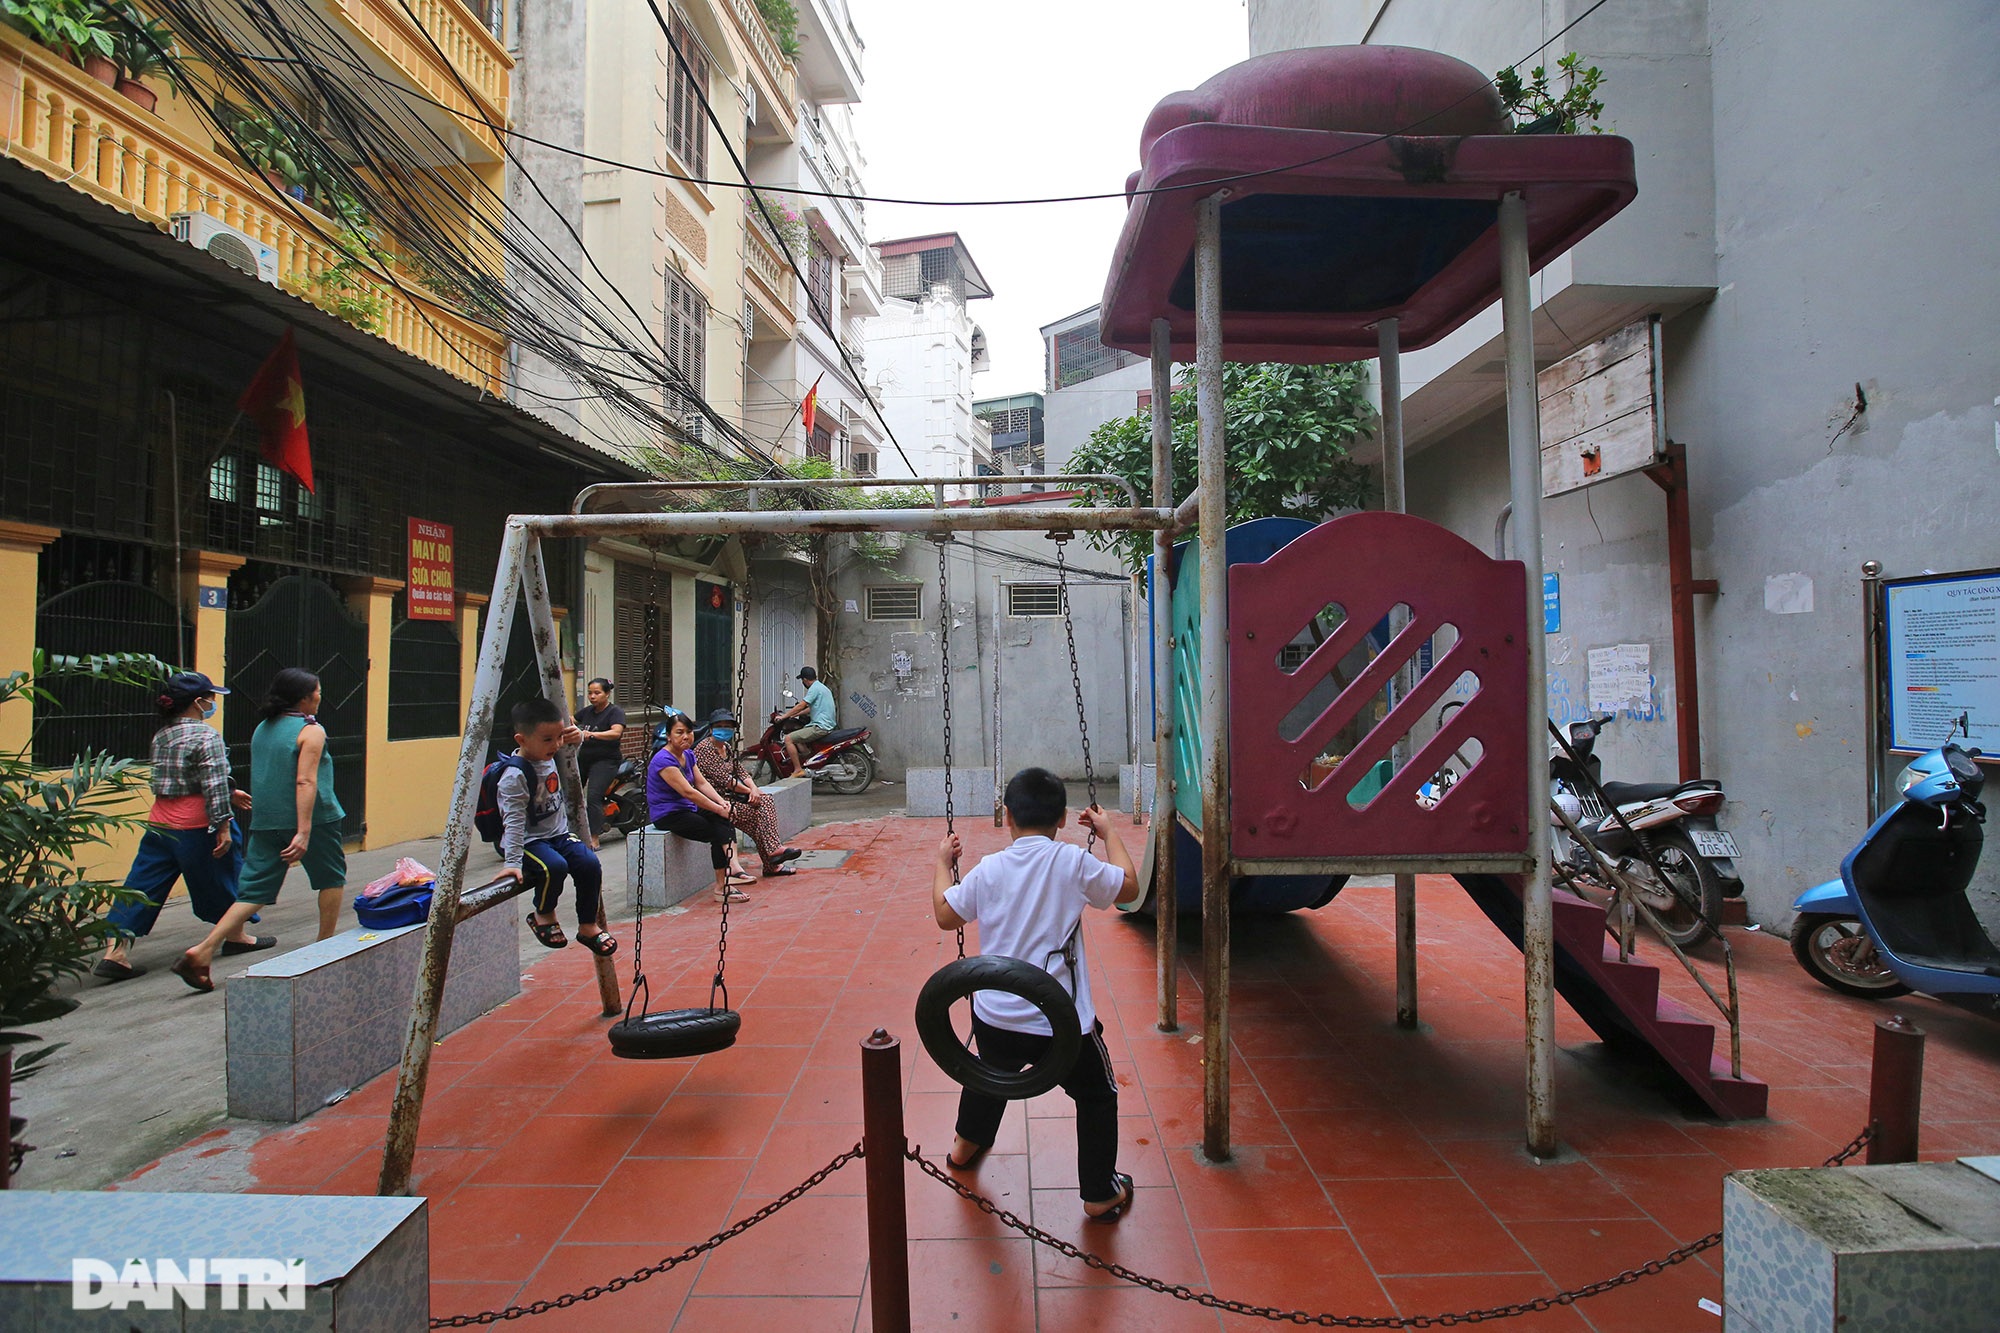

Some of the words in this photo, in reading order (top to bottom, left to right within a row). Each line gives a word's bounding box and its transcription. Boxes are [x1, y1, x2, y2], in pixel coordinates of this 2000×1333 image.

[418, 524, 446, 539] NHẬN
[412, 539, 435, 561] MAY
[438, 544, 451, 563] ĐO
[412, 561, 429, 586] SỬA
[431, 567, 452, 588] CHỮA
[208, 590, 218, 605] 3
[1947, 589, 1961, 597] QUY
[1697, 832, 1729, 844] 29-B1
[1699, 843, 1738, 856] 705.11
